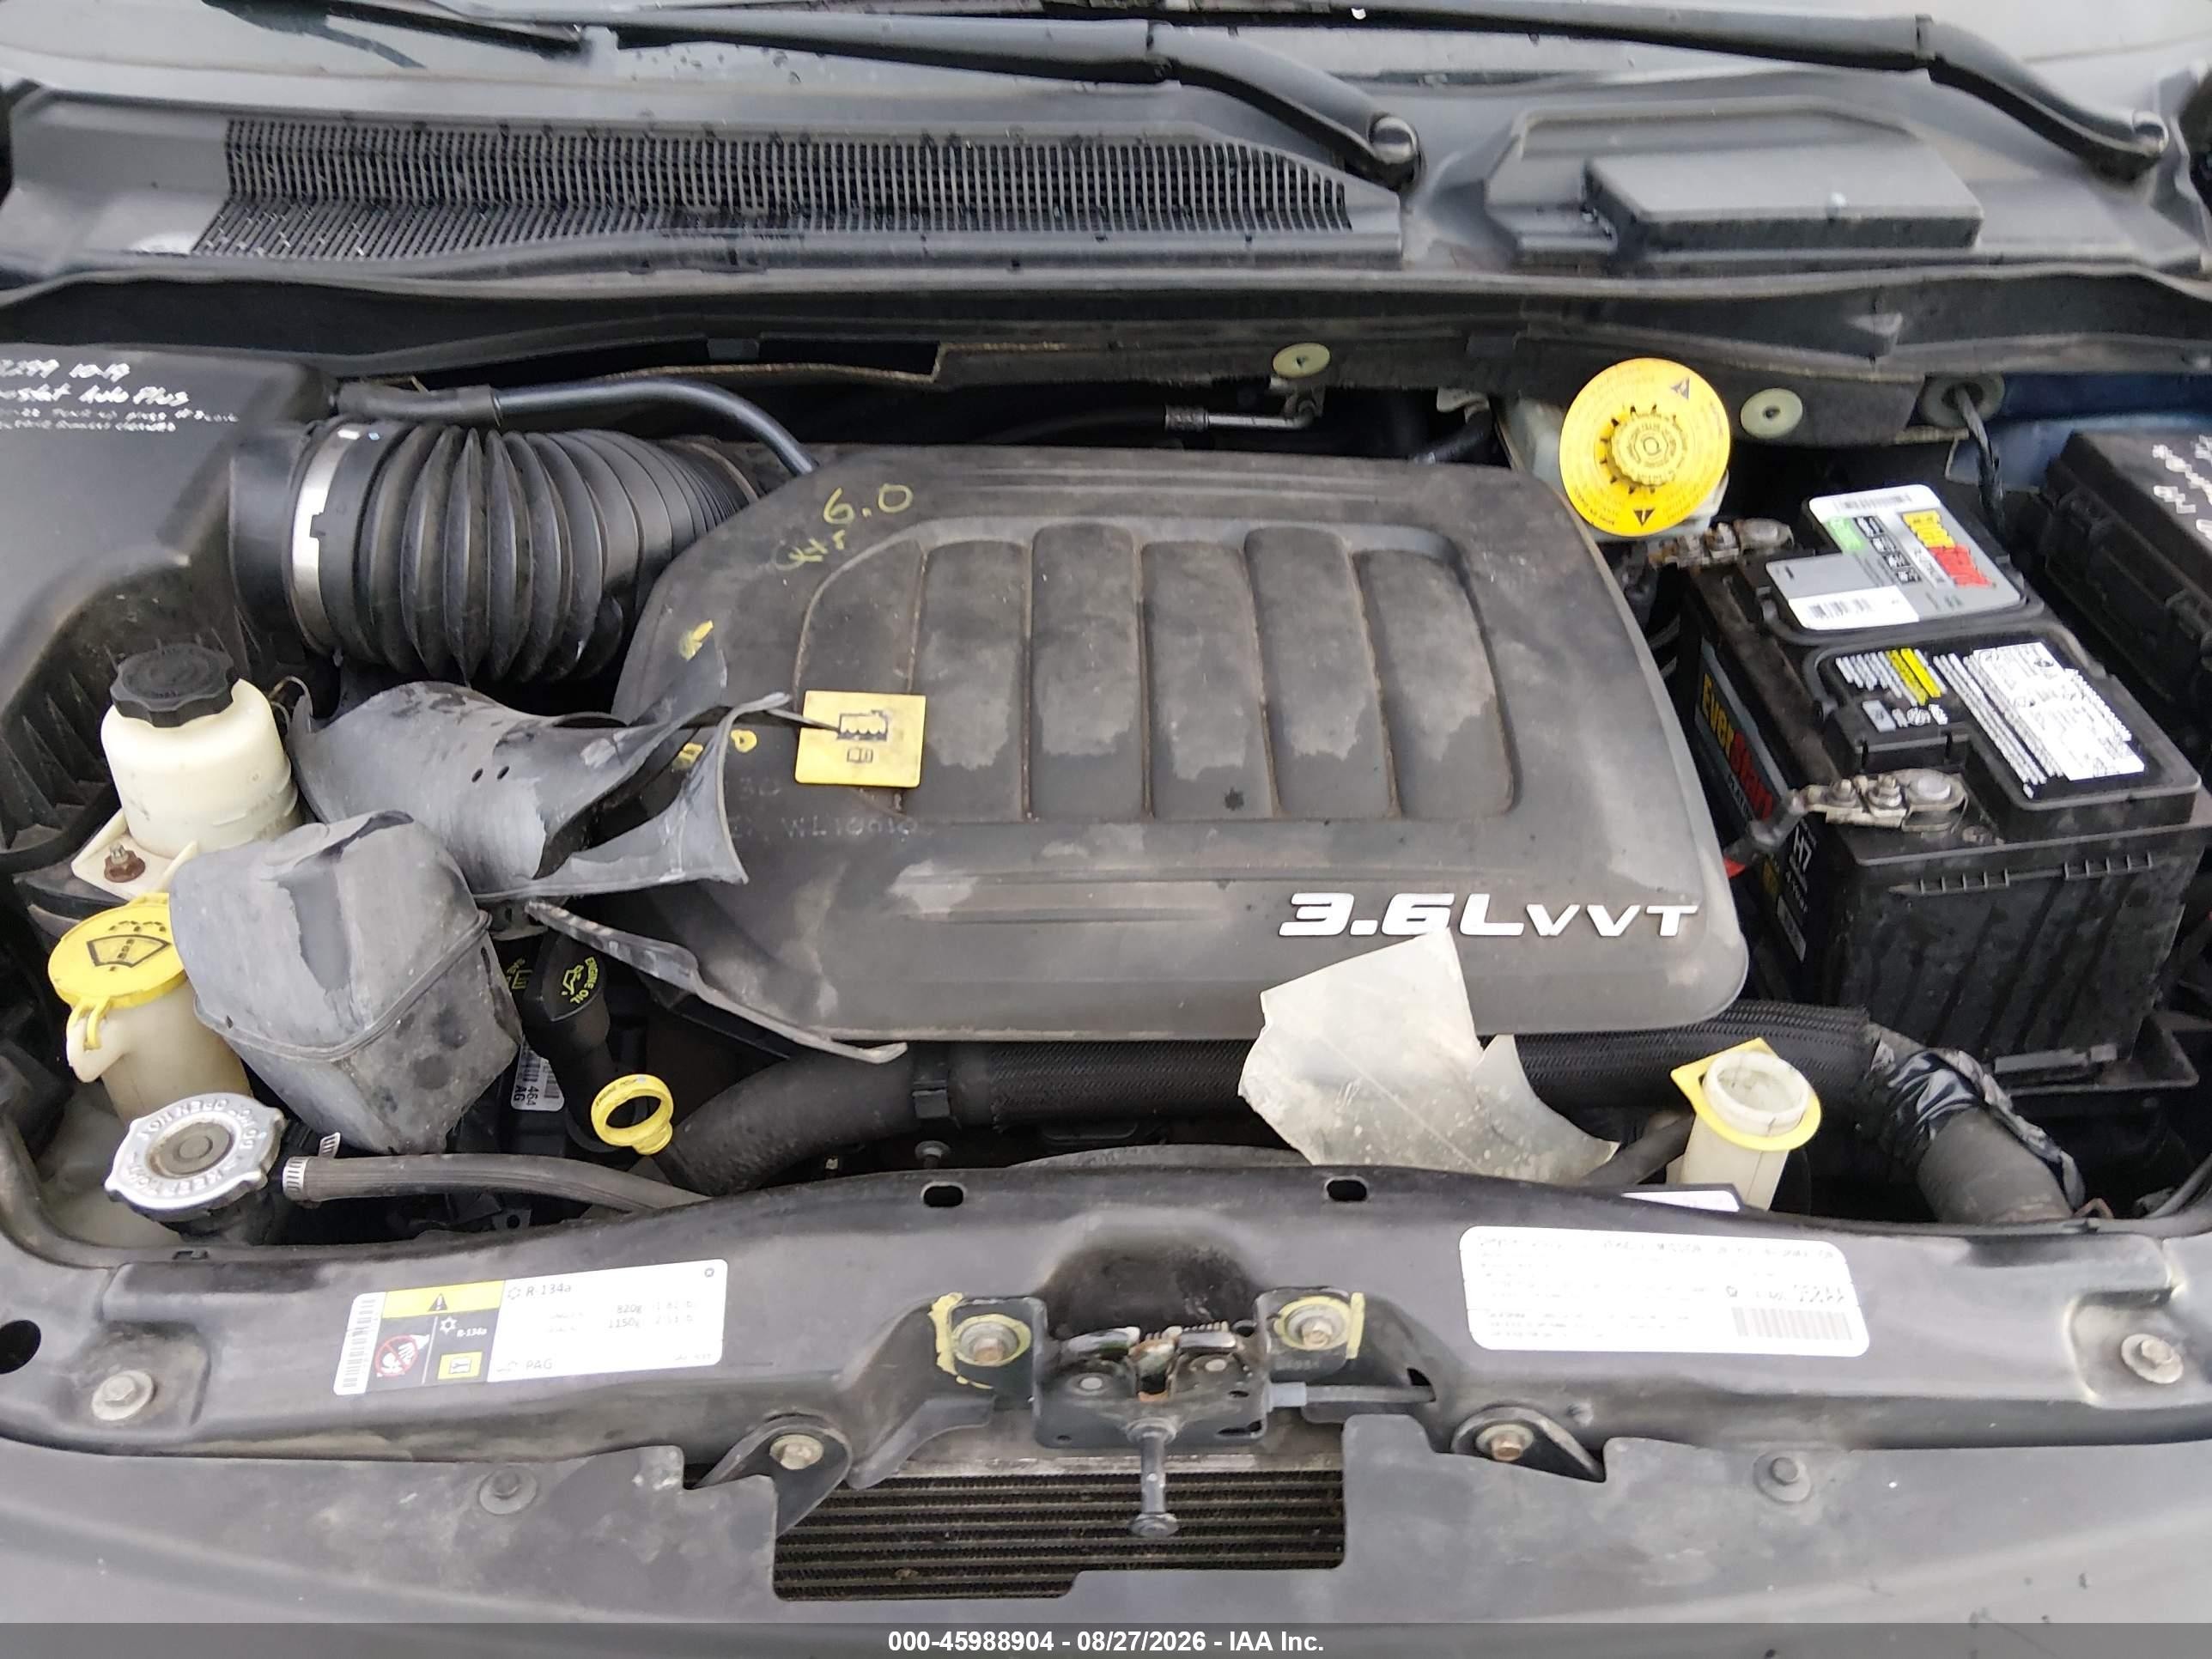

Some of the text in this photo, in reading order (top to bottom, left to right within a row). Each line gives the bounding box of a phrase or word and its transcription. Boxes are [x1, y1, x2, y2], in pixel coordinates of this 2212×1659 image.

[823, 483, 914, 525] 6.0
[1279, 893, 1525, 936] 3.6L
[570, 956, 599, 1005] ENGINE OIL
[526, 1358, 553, 1370] PAG
